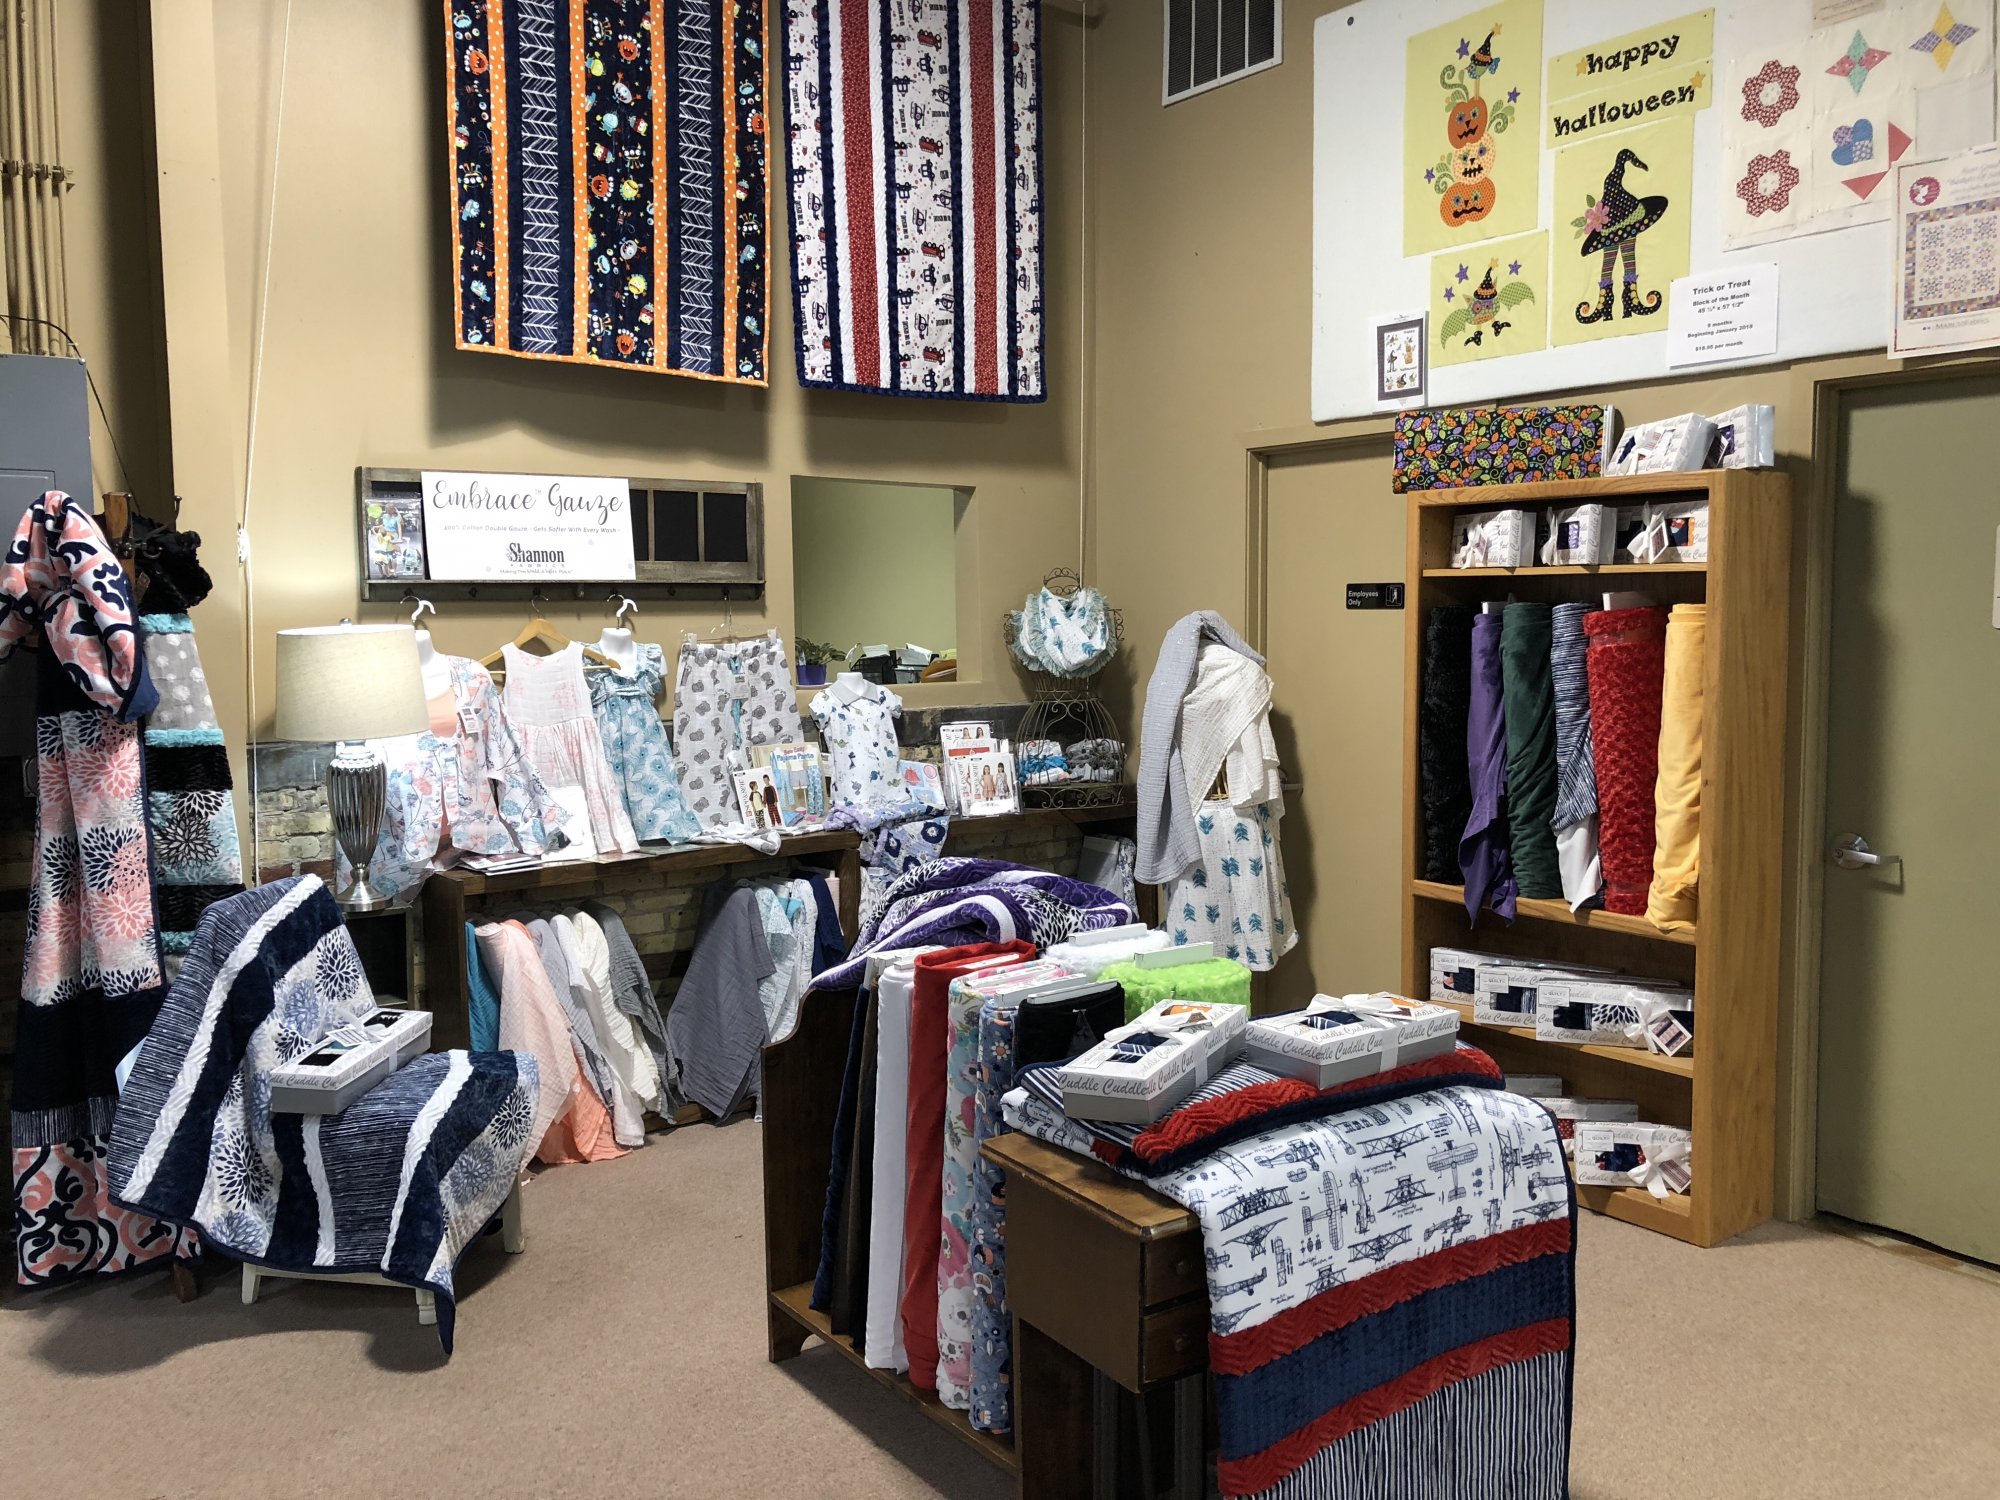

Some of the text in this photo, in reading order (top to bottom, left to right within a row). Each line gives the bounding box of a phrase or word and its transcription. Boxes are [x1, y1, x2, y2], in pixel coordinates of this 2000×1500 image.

[1585, 34, 1680, 75] happy
[1553, 84, 1695, 137] halloween
[1693, 286, 1714, 295] Trick
[1728, 280, 1751, 289] Treat
[1730, 292, 1750, 300] Month
[1687, 330, 1714, 339] Beginning
[1715, 327, 1738, 335] January
[433, 479, 536, 510] Embrace
[548, 483, 623, 526] Gauze
[509, 542, 565, 563] Shannon
[1348, 590, 1379, 599] Employees
[1348, 598, 1361, 607] Only
[1245, 1027, 1322, 1060] Cuddle Cuddle
[1335, 1041, 1365, 1060] Cuddle
[1397, 1026, 1425, 1045] Cuddle
[1427, 1019, 1454, 1037] Cuddle
[286, 1074, 319, 1087] Cuddle
[1058, 1073, 1149, 1096] Cuddle Cuddle
[1157, 1064, 1180, 1091] Cuddle
